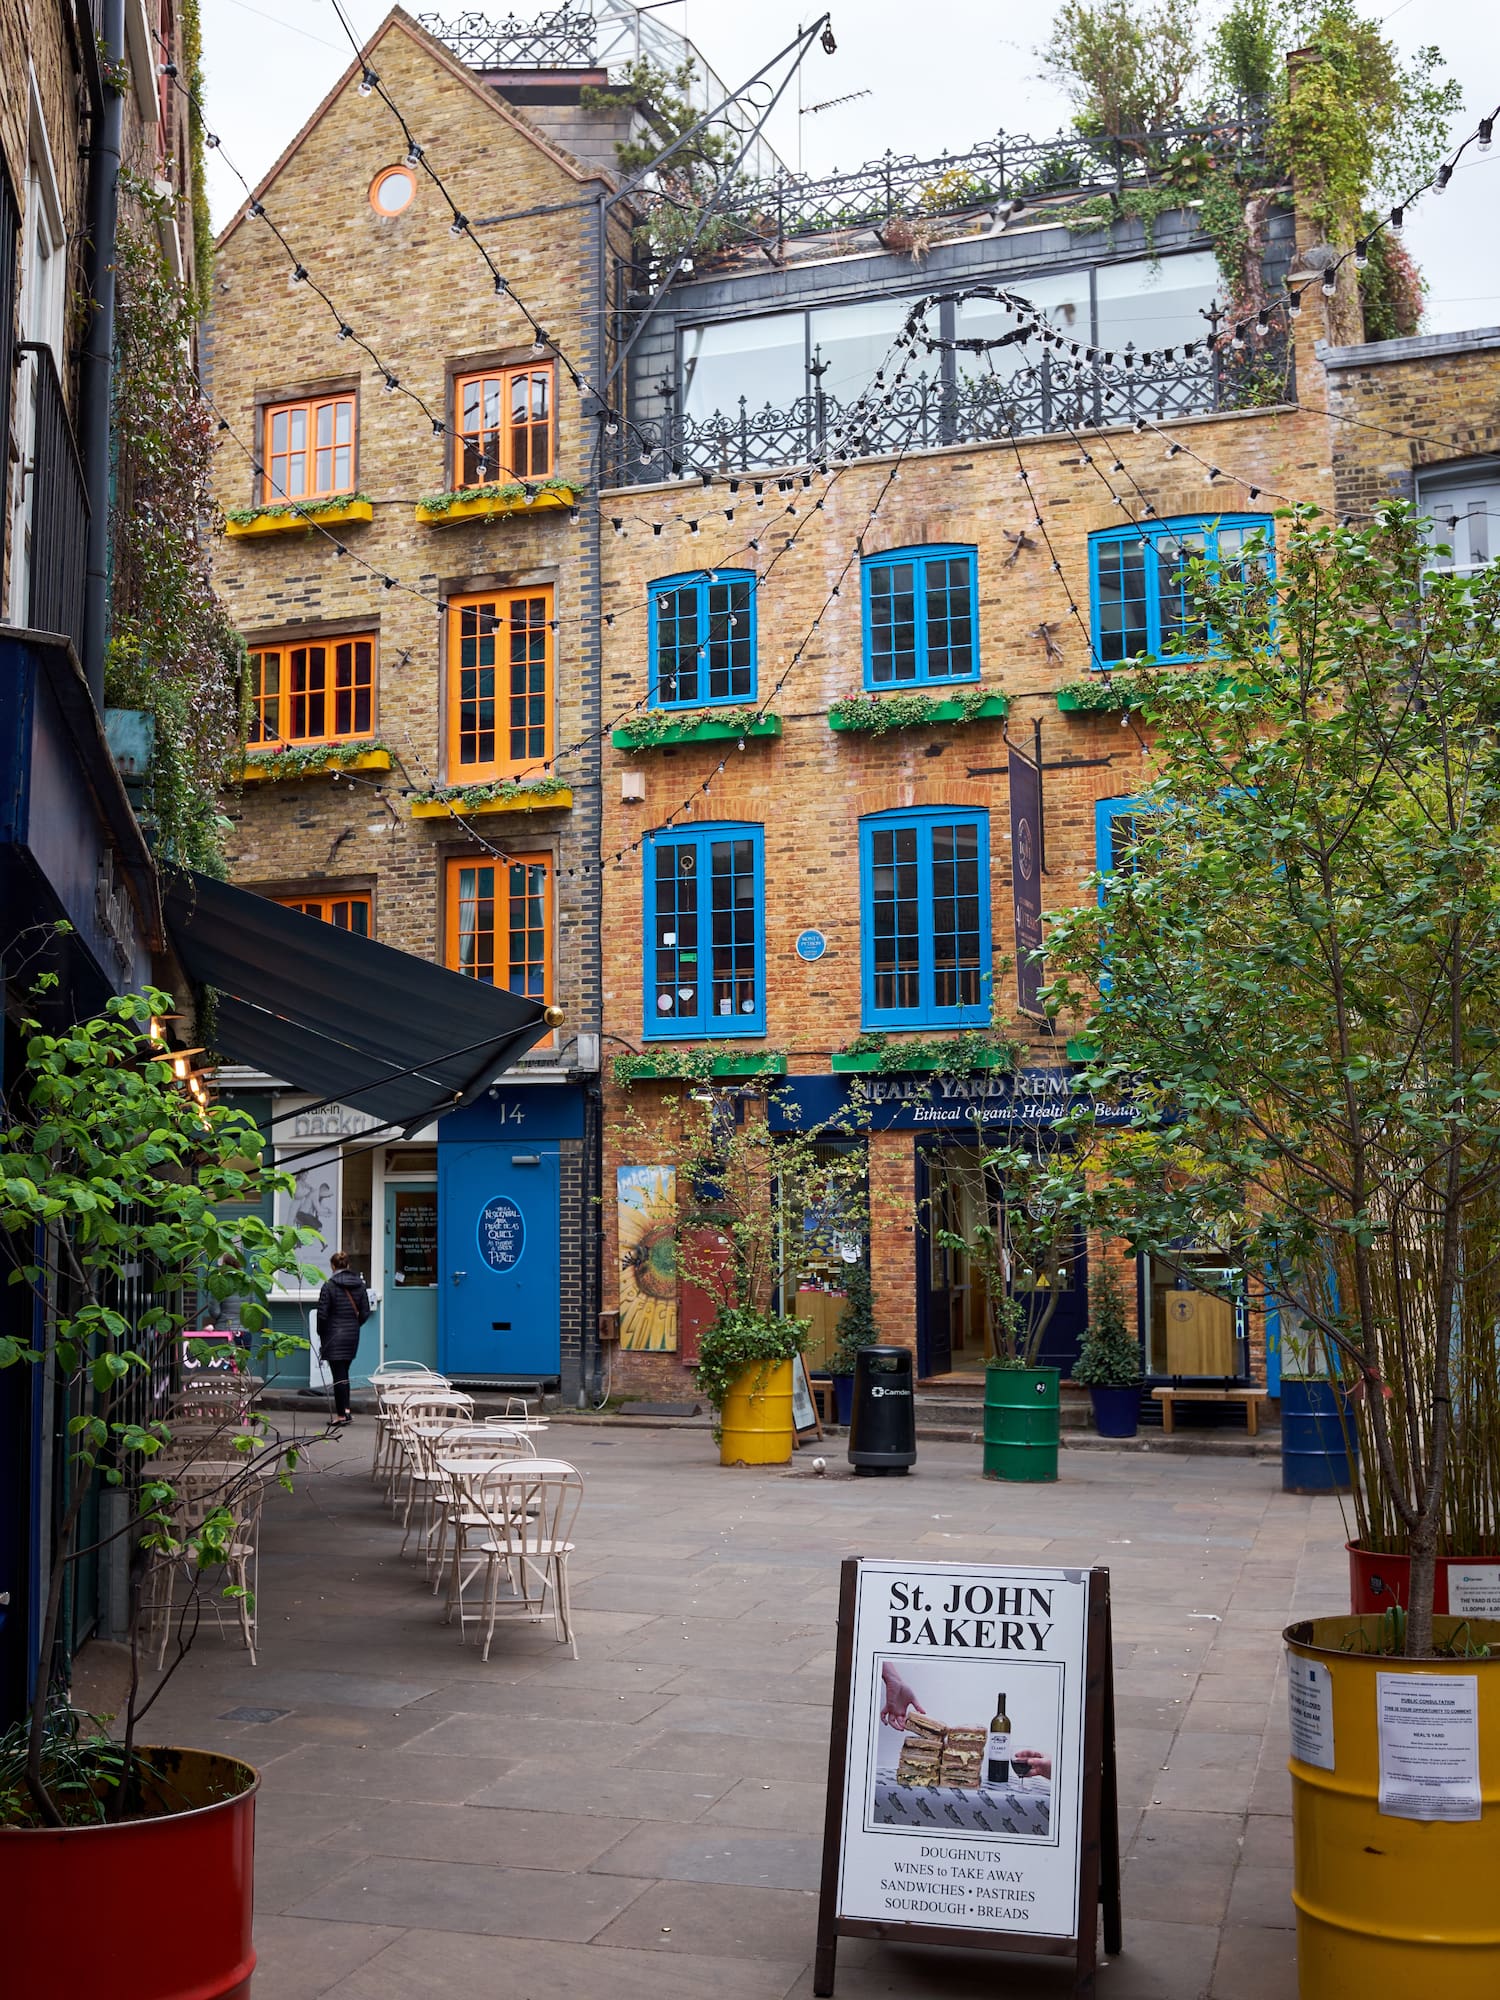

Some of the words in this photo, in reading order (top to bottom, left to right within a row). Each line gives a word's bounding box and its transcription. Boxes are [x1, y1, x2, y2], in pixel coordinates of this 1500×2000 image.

[937, 1076, 1005, 1099] YARD
[501, 1103, 526, 1125] 14
[913, 1106, 960, 1121] Ethical
[965, 1104, 1018, 1122] Organic
[884, 1388, 911, 1396] Camden
[889, 1581, 932, 1612] St.
[943, 1584, 1055, 1618] JOHN
[887, 1615, 1055, 1651] BAKERY
[920, 1846, 1001, 1863] DOUGHNUTS
[894, 1862, 934, 1877] WINES
[937, 1866, 948, 1877] to
[950, 1866, 985, 1880] TAKE
[986, 1870, 1024, 1883] AWAY
[880, 1879, 965, 1897] SANDWICHES
[976, 1887, 1036, 1902] PASTRIES
[885, 1897, 966, 1915] SOURDOUGH
[977, 1905, 1030, 1920] BREADS
